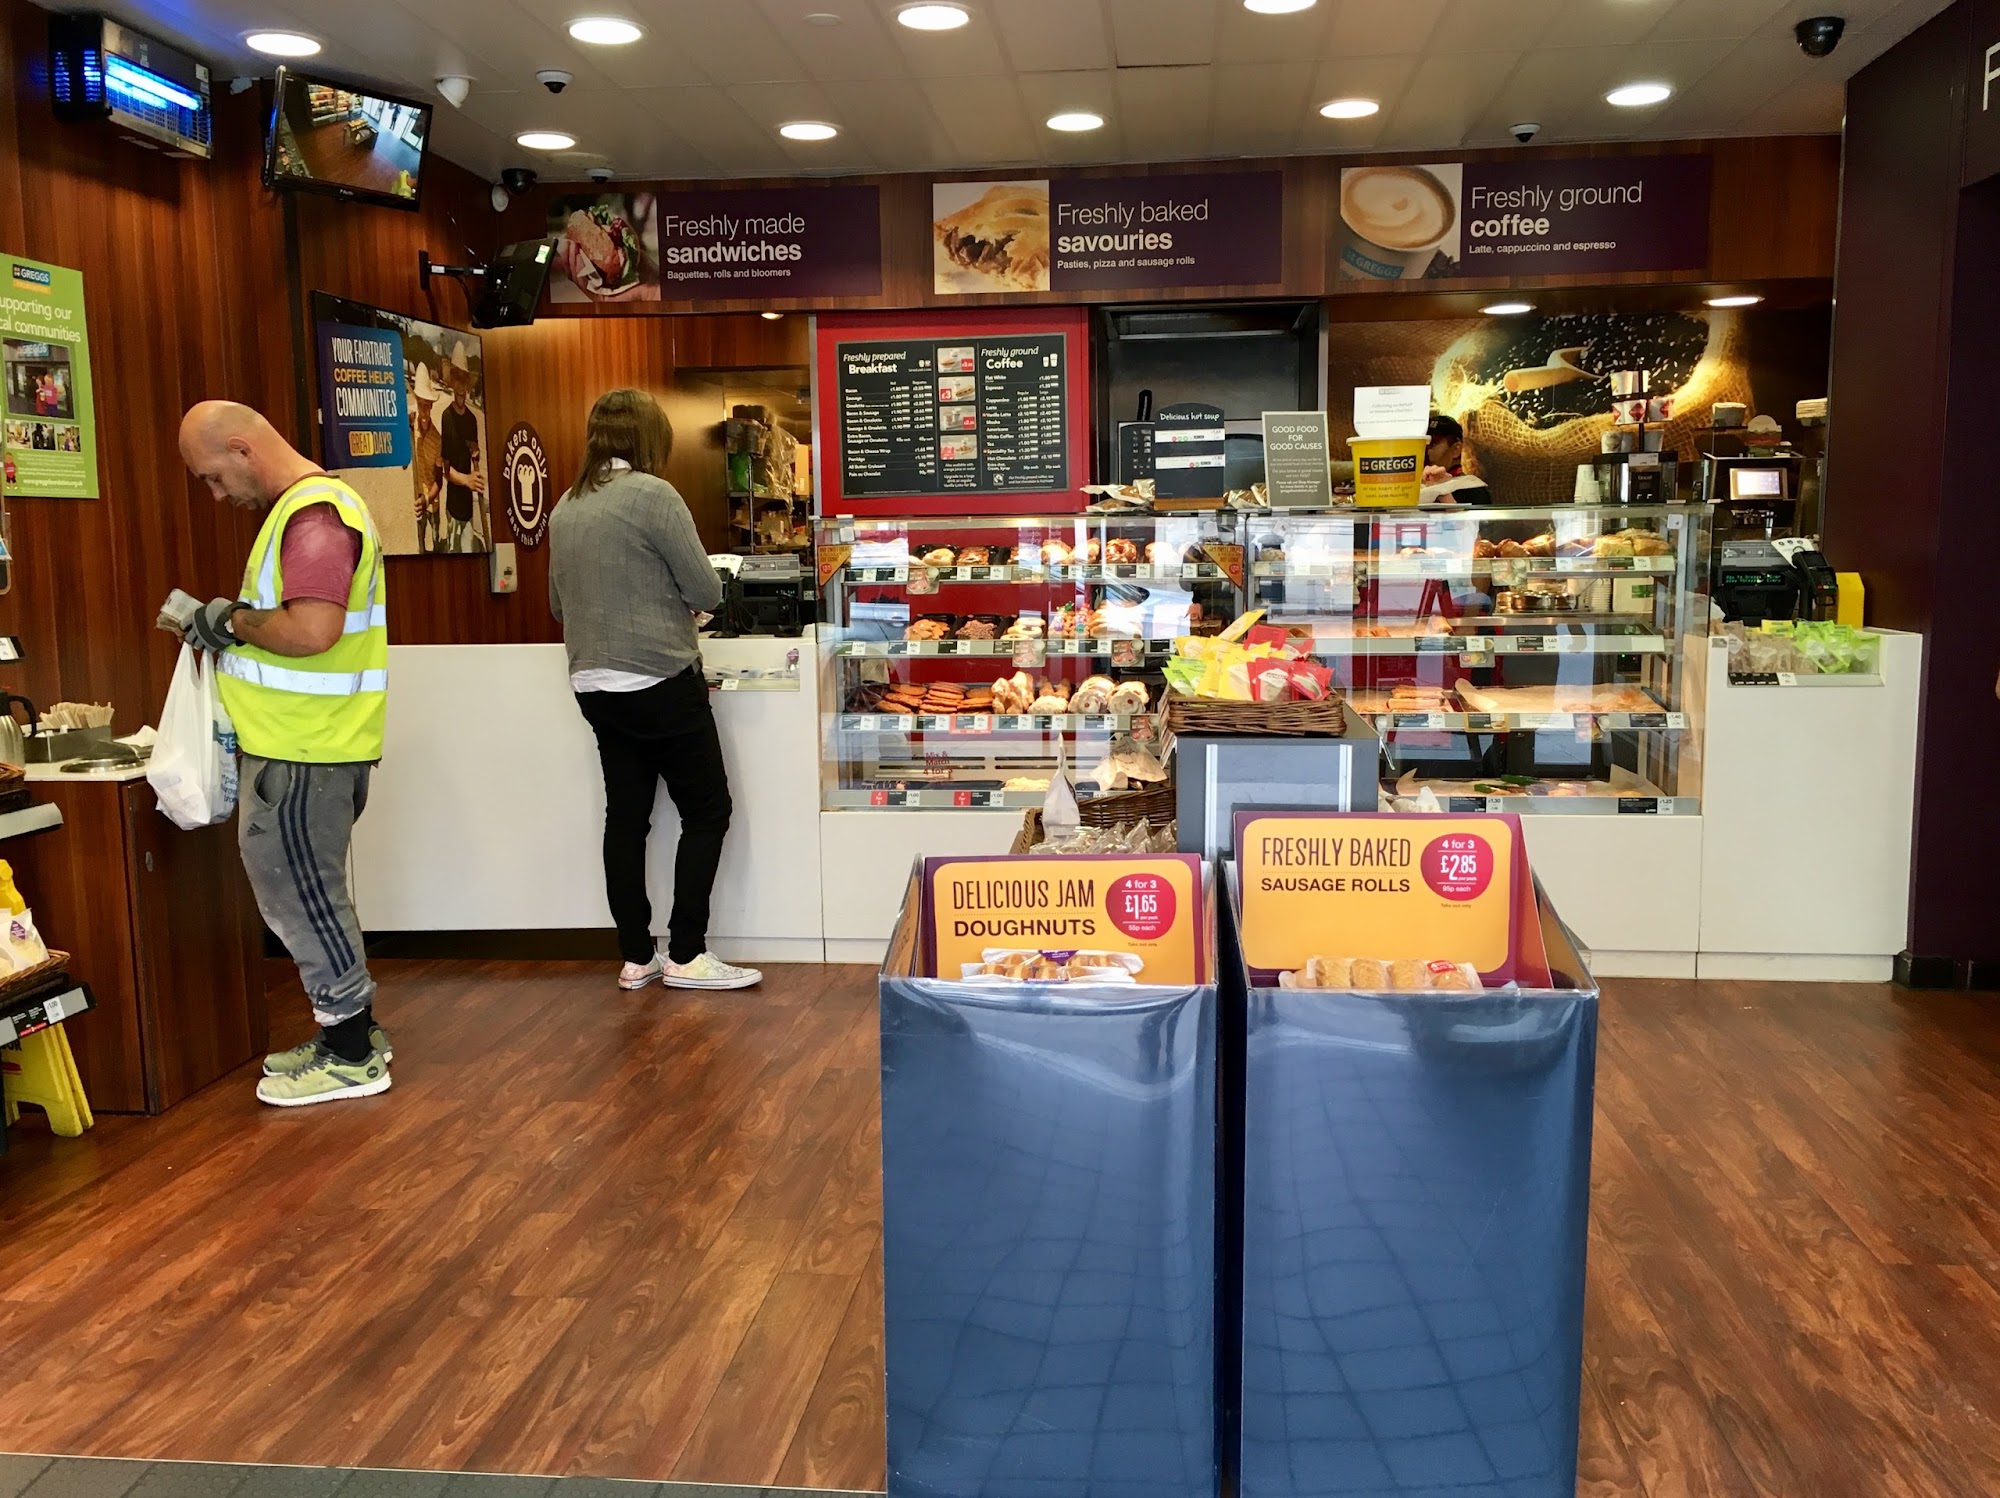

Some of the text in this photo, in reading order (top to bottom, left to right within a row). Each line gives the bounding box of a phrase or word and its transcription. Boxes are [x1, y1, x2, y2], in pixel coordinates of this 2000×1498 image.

[1472, 181, 1642, 212] Freshly ground
[1058, 199, 1208, 228] Freshly baked
[666, 212, 805, 240] Freshly made
[1470, 214, 1549, 237] coffee
[1058, 229, 1172, 253] savouries
[1469, 240, 1616, 254] Latte, cappuccino and espresso
[667, 240, 801, 264] sandwiches
[1057, 256, 1195, 269] Pasties, pizza and sausage rolls
[1357, 256, 1400, 278] GREGGS
[21, 268, 49, 282] GREGGS
[668, 269, 790, 281] Baguettes, rolls and bloomers
[55, 308, 72, 319] our
[15, 321, 80, 342] communities
[332, 337, 393, 366] YOUR FAIRTRADE
[843, 351, 906, 363] Freshly prepared
[981, 346, 1039, 357] Freshly ground
[849, 363, 897, 374] Breakfast
[986, 358, 1023, 369] Coffee
[334, 368, 394, 384] COFFEE HELPS
[336, 388, 397, 417] COMMUNITIES
[1204, 413, 1219, 421] soup
[350, 432, 392, 454] GREAT DAYS
[503, 430, 547, 479] bakers only
[1370, 458, 1415, 471] GREGGS
[521, 534, 533, 545] this
[1262, 837, 1411, 867] FRESHLY BAKED
[1442, 840, 1474, 849] 4 for 3
[1441, 855, 1476, 880] £2.85
[1125, 880, 1157, 888] 4 for 3
[1261, 878, 1410, 892] SAUSAGE ROLLS
[953, 880, 1094, 910] DELICIOUS JAM
[1125, 895, 1157, 919] £1.65
[954, 919, 1096, 937] DOUGHNUTS
